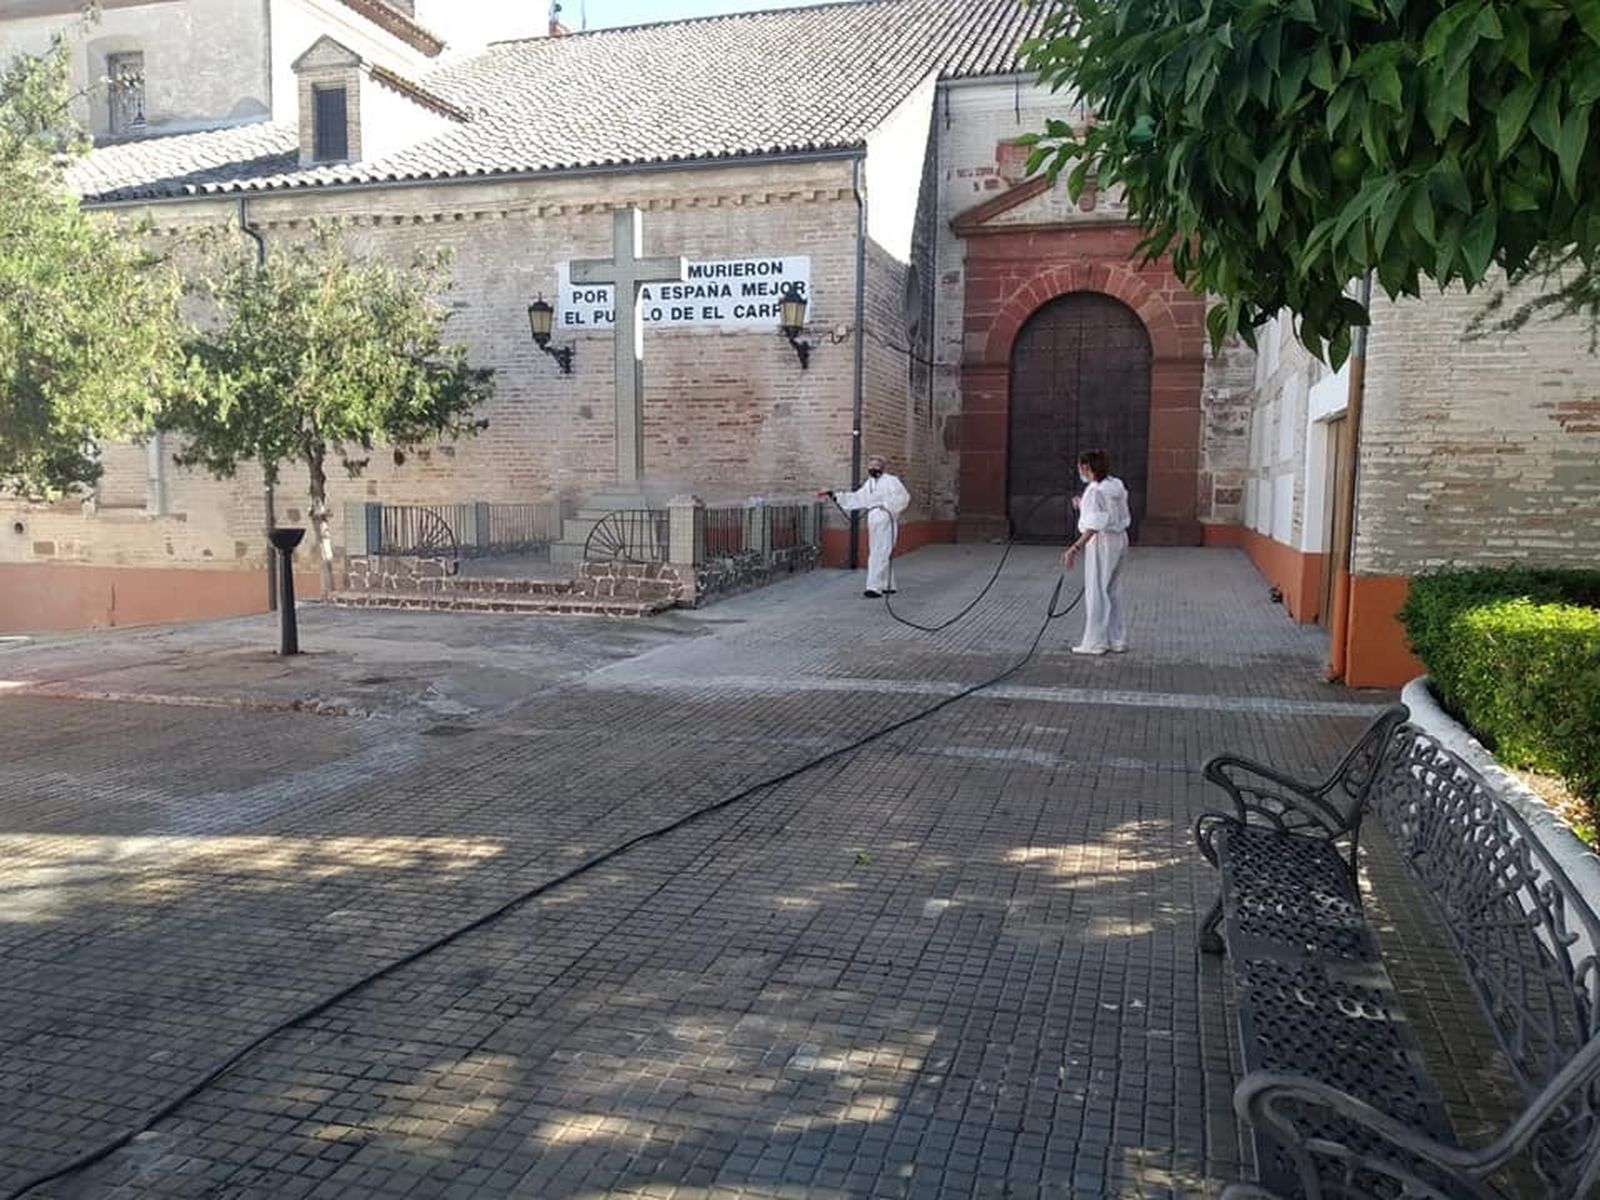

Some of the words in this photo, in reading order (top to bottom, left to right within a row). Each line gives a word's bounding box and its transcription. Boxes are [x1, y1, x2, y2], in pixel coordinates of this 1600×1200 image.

[688, 261, 783, 279] MURIERON
[573, 290, 608, 304] POR
[660, 281, 732, 300] ESPAÑA
[741, 281, 805, 297] MEJOR
[565, 311, 585, 324] EL
[593, 307, 663, 324] PUO
[671, 306, 694, 321] DE
[702, 306, 724, 320] EL
[733, 303, 782, 319] CARP
